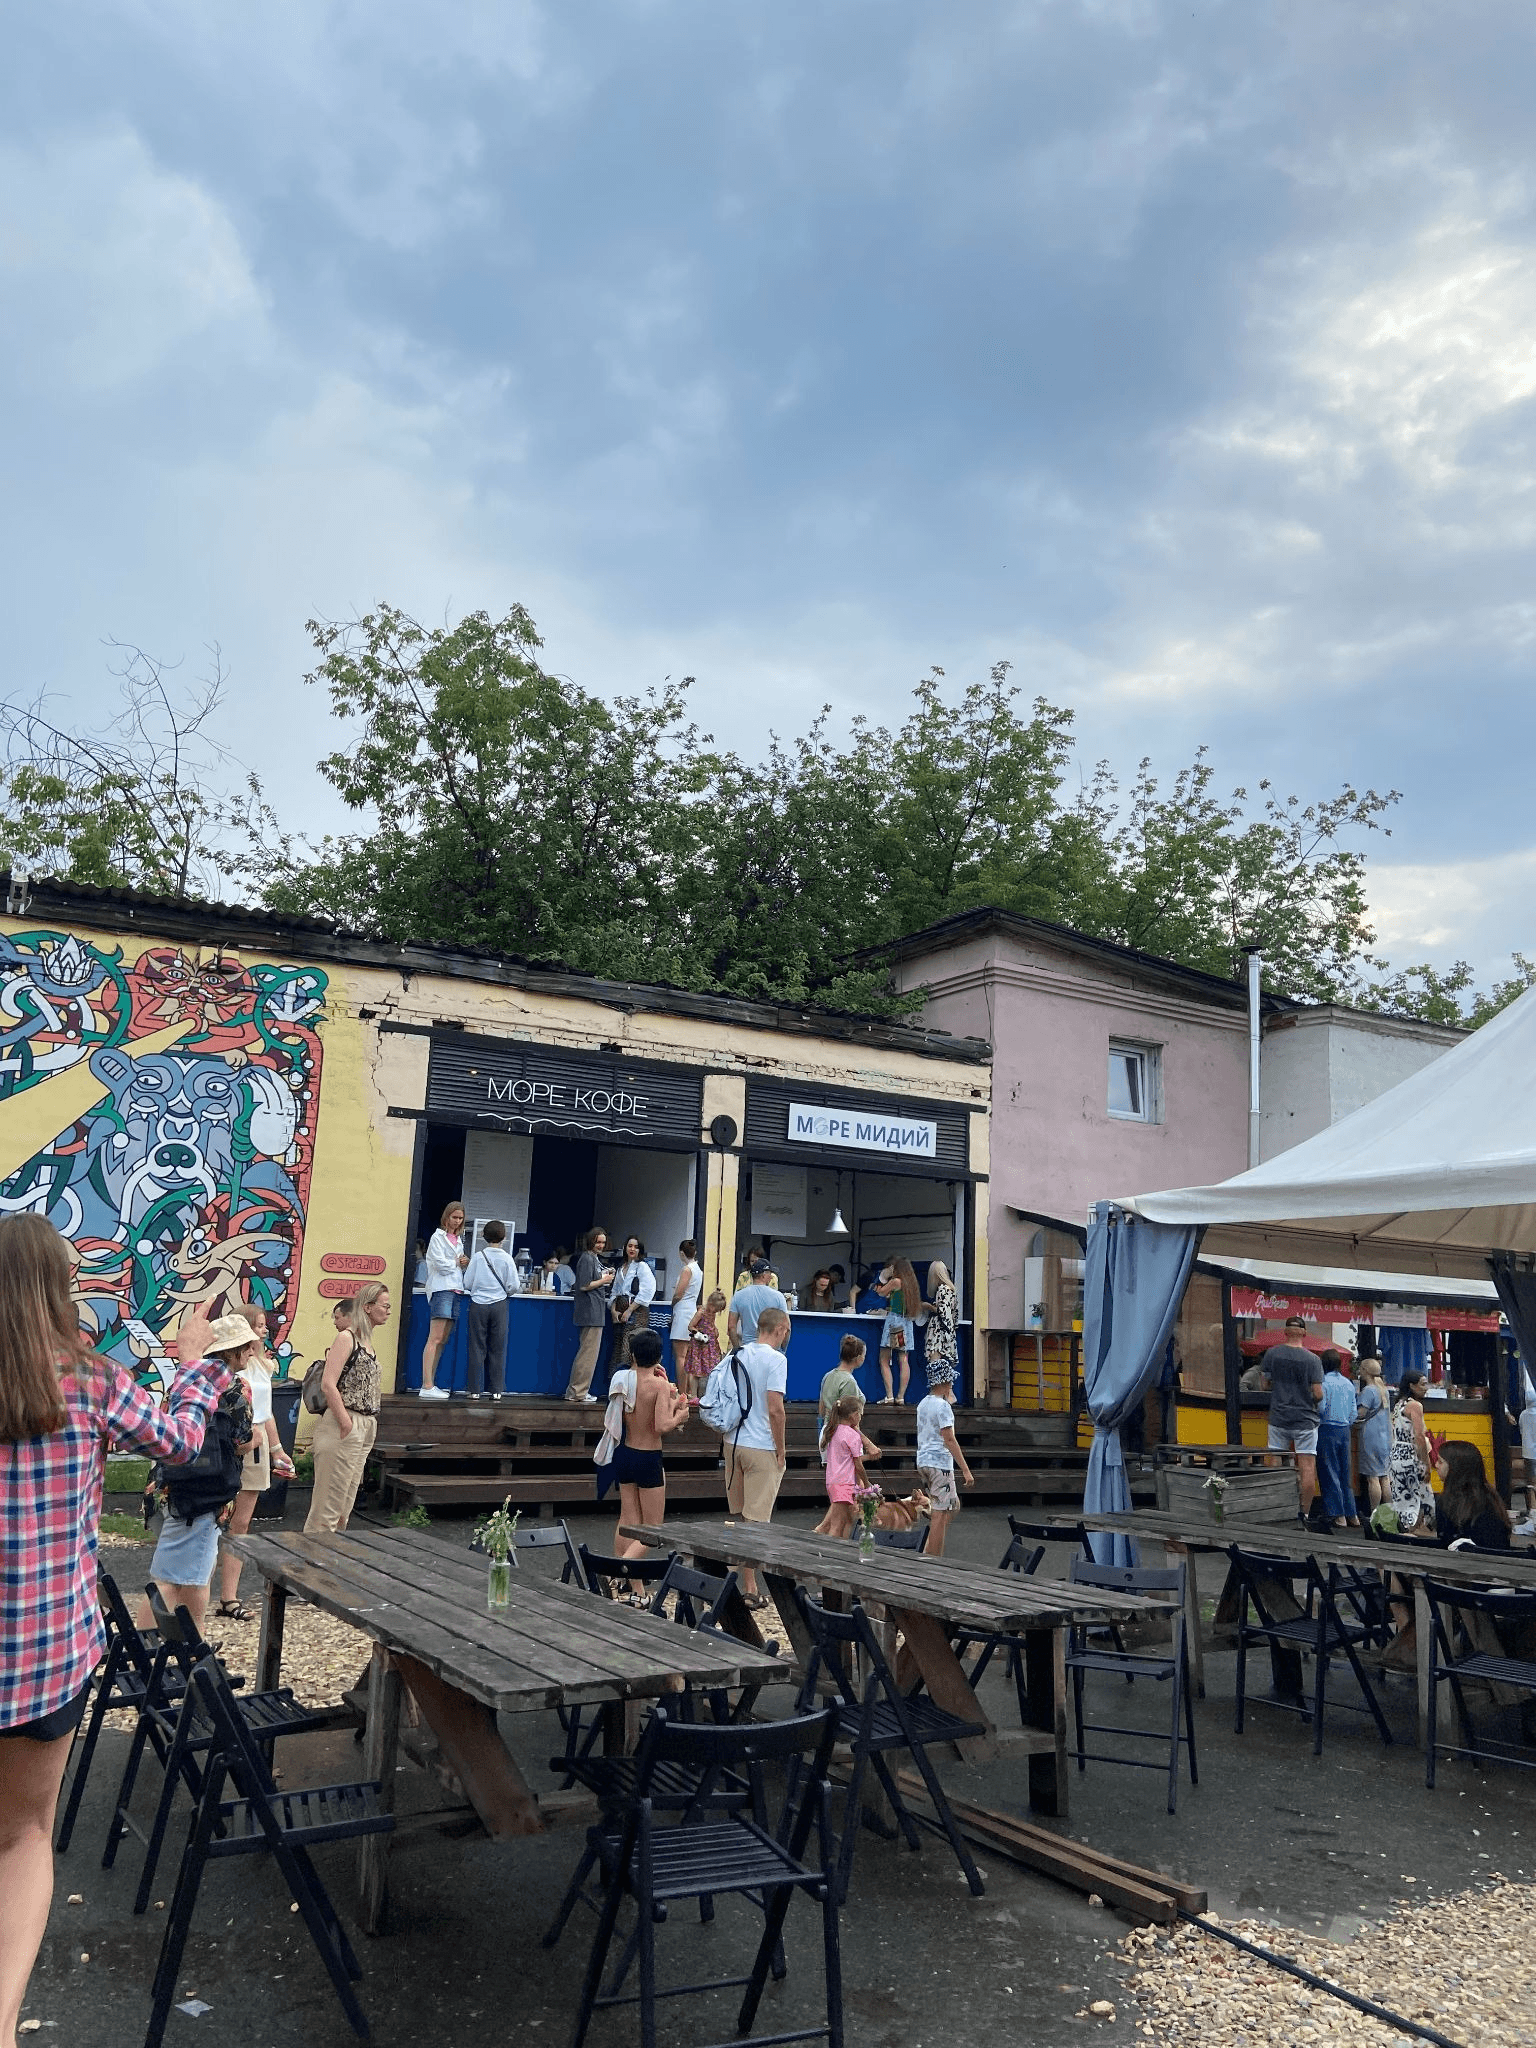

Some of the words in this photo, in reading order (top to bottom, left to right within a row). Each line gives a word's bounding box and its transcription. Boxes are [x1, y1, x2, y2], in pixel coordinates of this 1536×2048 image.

[488, 1077, 567, 1107] МОРЕ
[574, 1088, 649, 1118] КОФЕ
[855, 1122, 930, 1149] МИДИЙ
